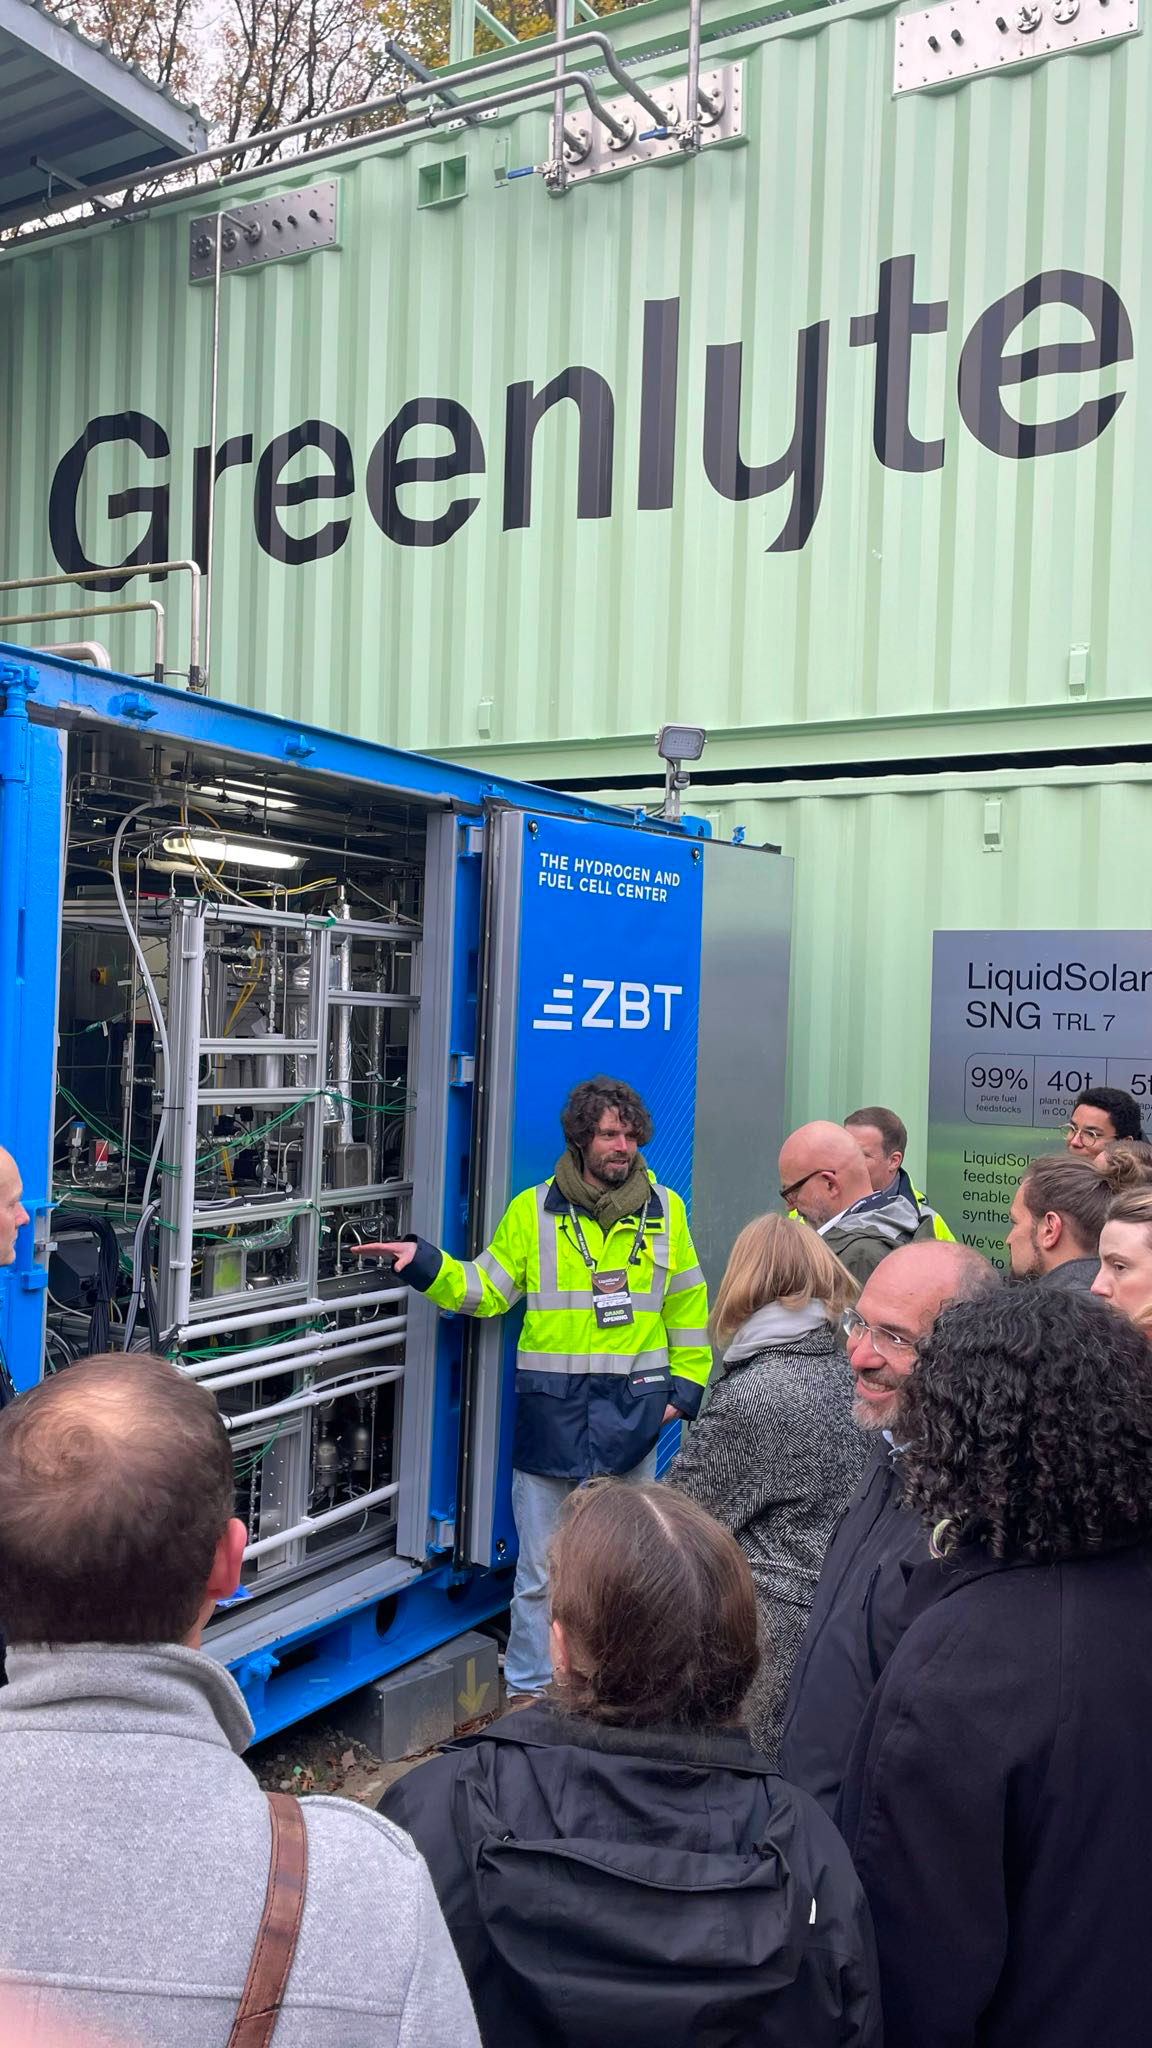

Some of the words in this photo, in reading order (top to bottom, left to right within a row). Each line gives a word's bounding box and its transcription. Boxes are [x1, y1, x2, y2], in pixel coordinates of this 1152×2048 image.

[48, 253, 1135, 593] Greenlyte
[539, 852, 569, 871] THE
[573, 858, 651, 883] HYDROGEN
[654, 870, 681, 888] AND
[538, 872, 574, 891] FUEL
[579, 878, 612, 896] CELL
[616, 883, 668, 903] CENTER
[967, 961, 1152, 996] LiquidSolar
[581, 978, 683, 1031] ZBT
[966, 1001, 1041, 1030] SNG
[1052, 1012, 1096, 1031] TRL
[1103, 1014, 1116, 1031] 7
[971, 1066, 1028, 1091] 99%
[1047, 1070, 1093, 1093] 40t
[980, 1094, 1001, 1103] pure
[1001, 1094, 1018, 1103] fuel
[1039, 1096, 1061, 1105] plant
[975, 1103, 1022, 1114] feedstocks
[1042, 1107, 1051, 1115] in
[962, 1190, 1010, 1204] enable
[962, 1209, 1009, 1223] synthe
[602, 1314, 628, 1323] OPENING
[604, 1309, 625, 1317] GRAND
